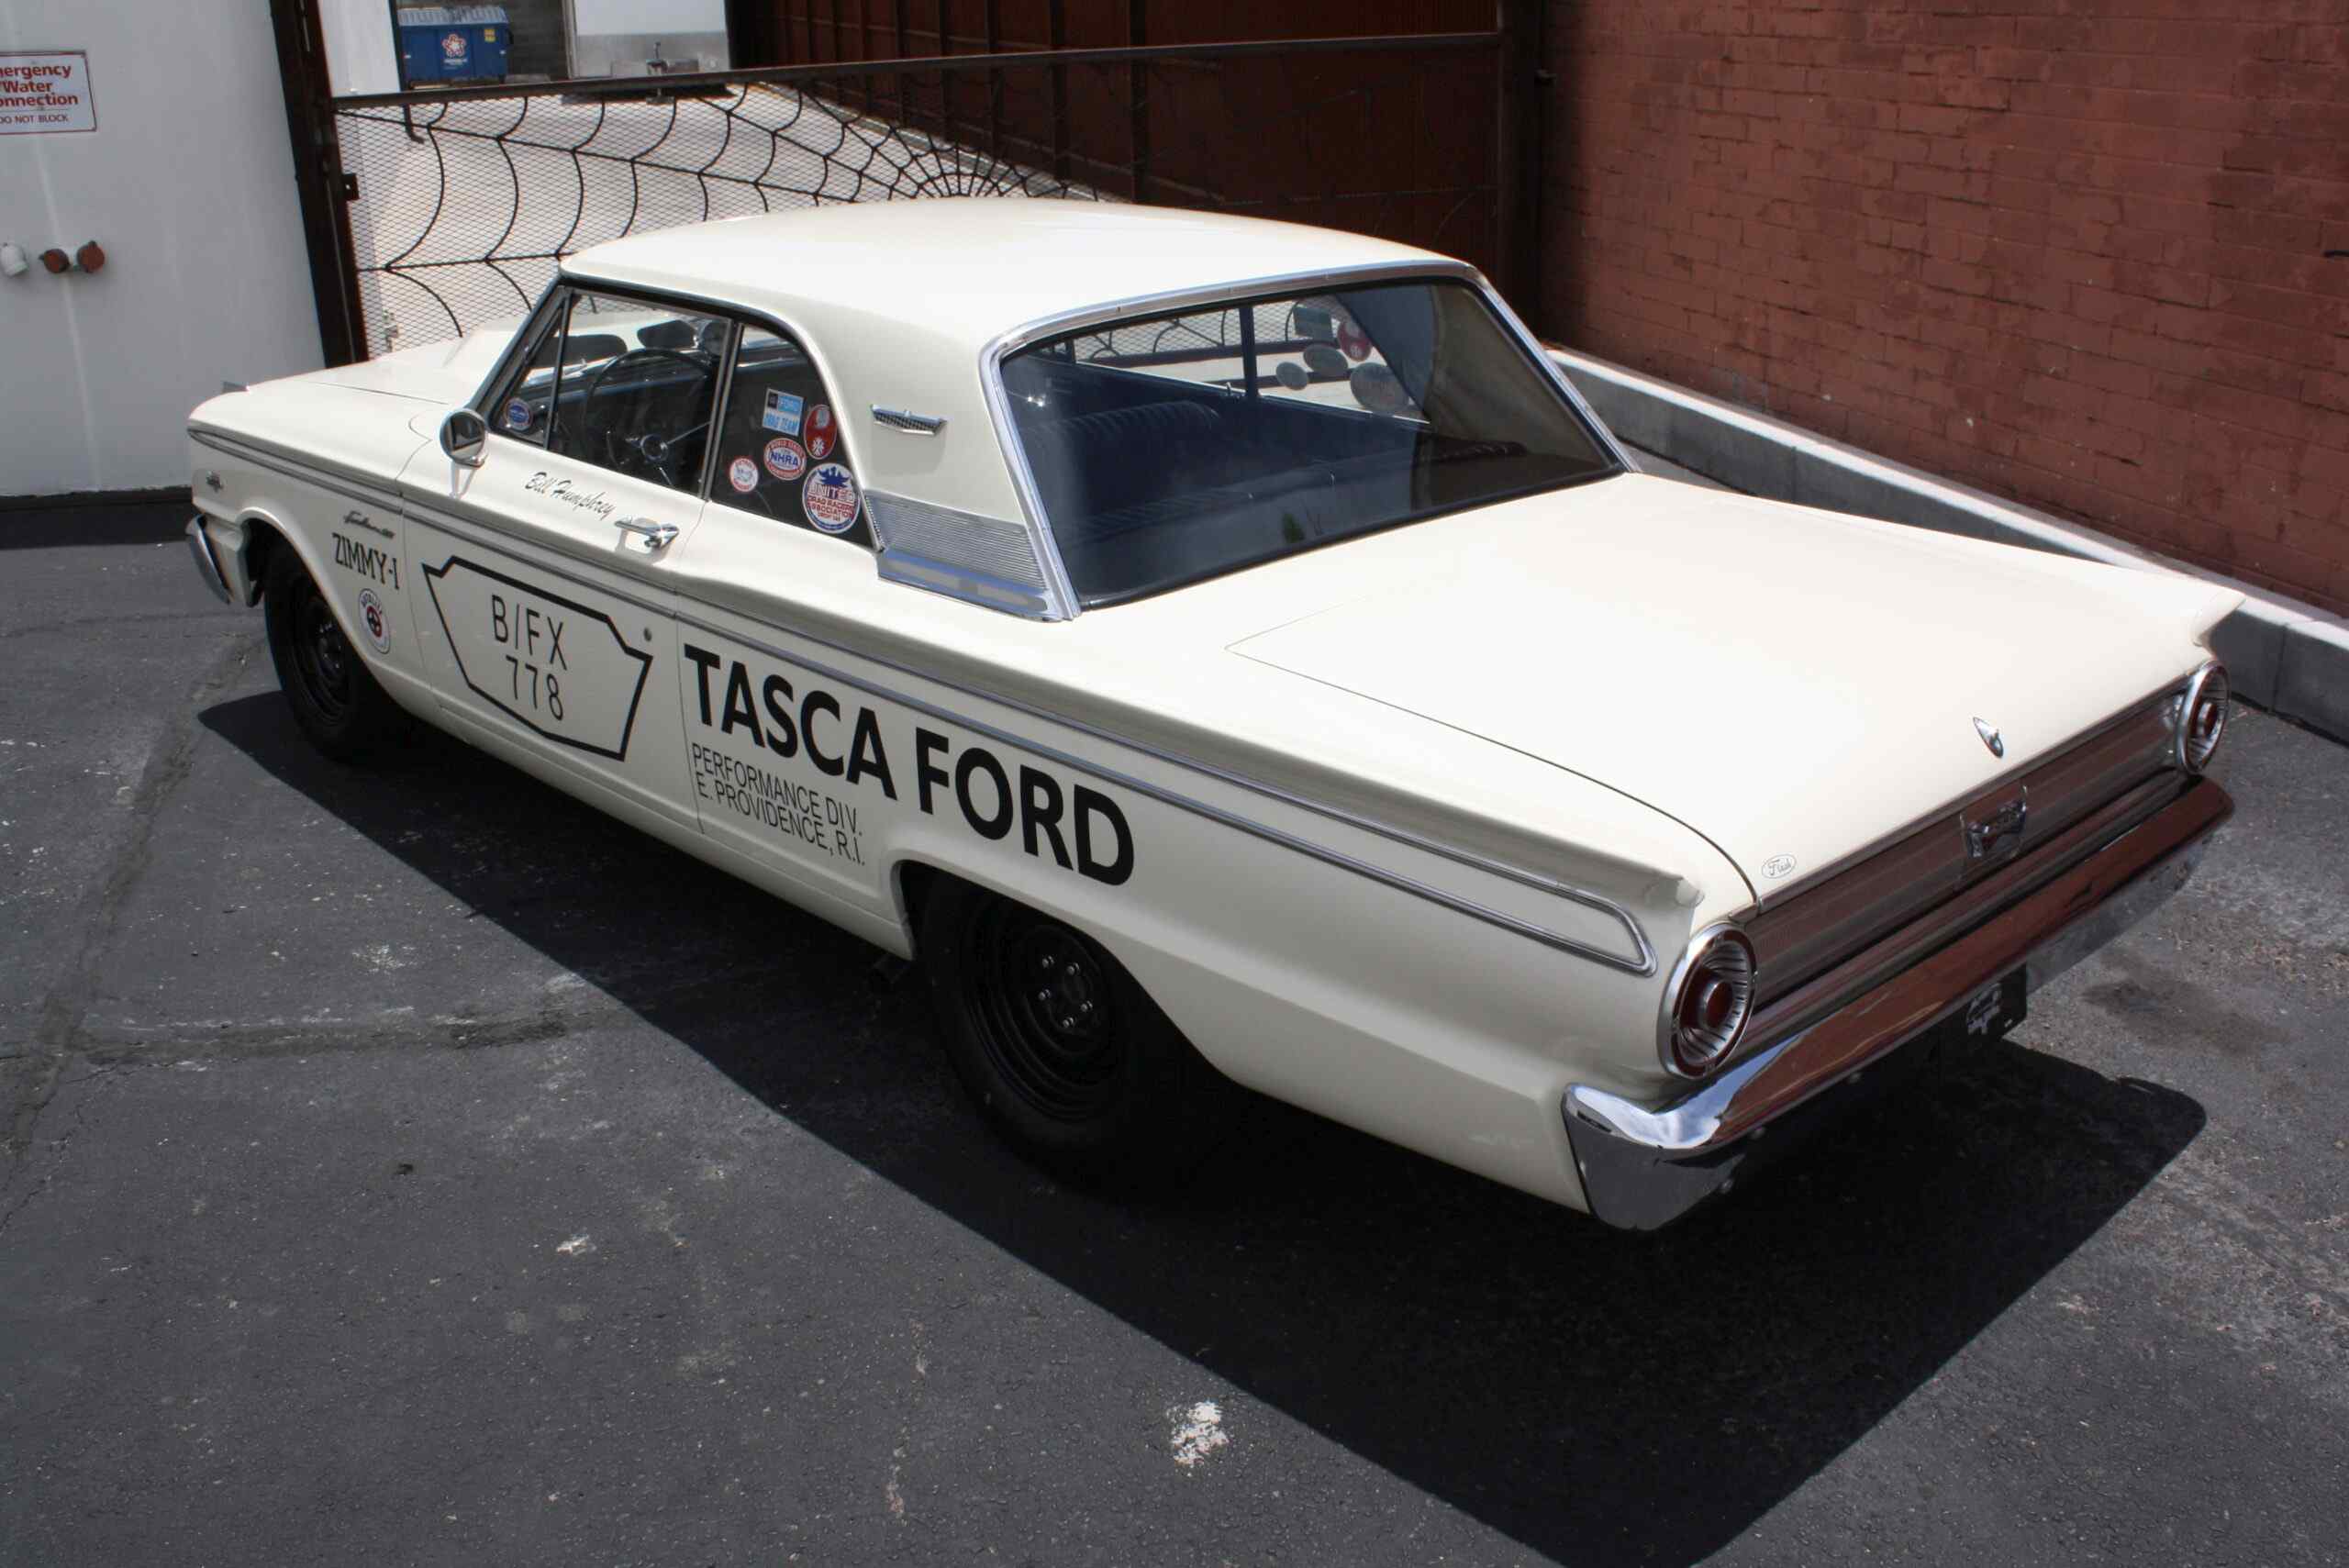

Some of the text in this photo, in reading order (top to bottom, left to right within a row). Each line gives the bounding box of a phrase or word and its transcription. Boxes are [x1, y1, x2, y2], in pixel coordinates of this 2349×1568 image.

[0, 65, 72, 79] ergency
[15, 115, 36, 124] NOT
[38, 113, 69, 123] BLOCK
[771, 450, 798, 466] NHRA
[492, 595, 567, 671] B/FX
[506, 654, 563, 721] 778
[685, 643, 1135, 887] TASCA FORD
[692, 743, 863, 837] PERFORMANCE DIV.
[696, 772, 866, 866] E. PROVIDENCE, R.I.
